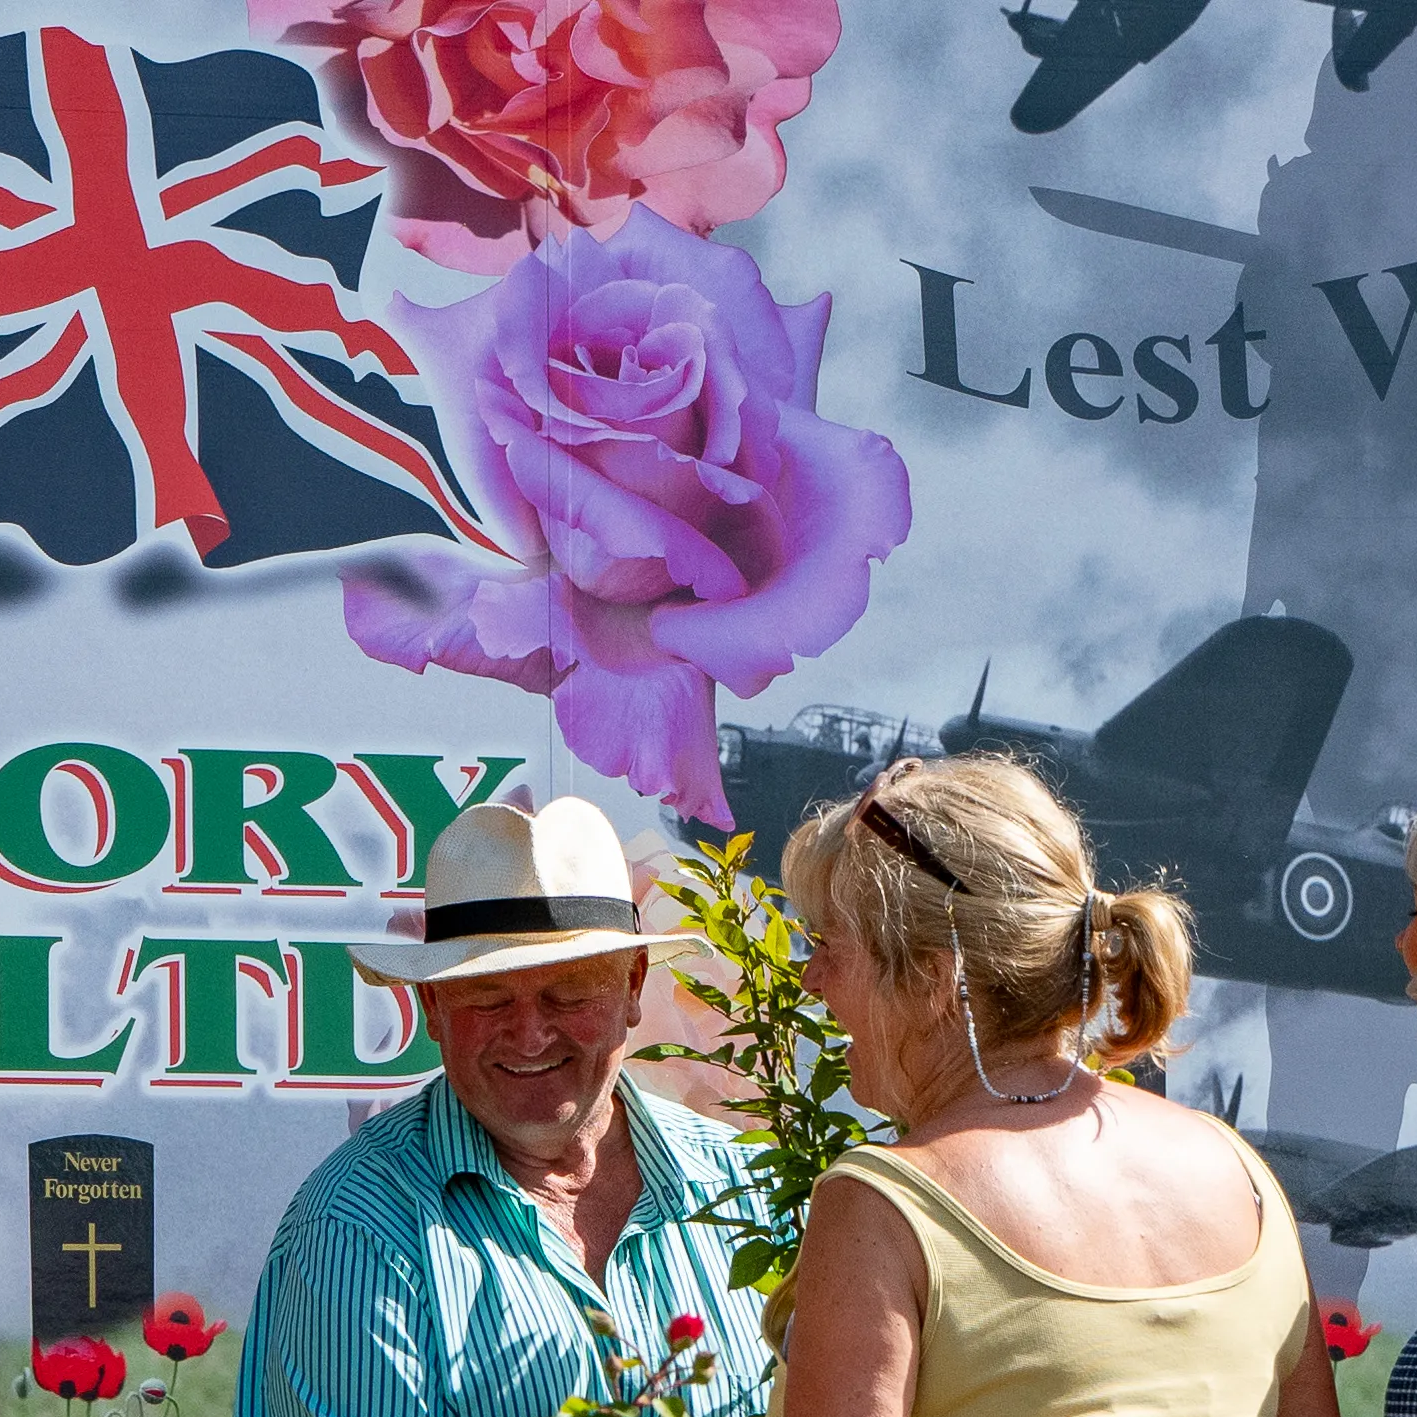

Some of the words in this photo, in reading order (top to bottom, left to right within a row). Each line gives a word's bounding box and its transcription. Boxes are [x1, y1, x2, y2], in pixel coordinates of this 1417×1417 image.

[899, 257, 1271, 424] Lest
[62, 1151, 122, 1173] Never
[43, 1177, 143, 1205] Forgotten
